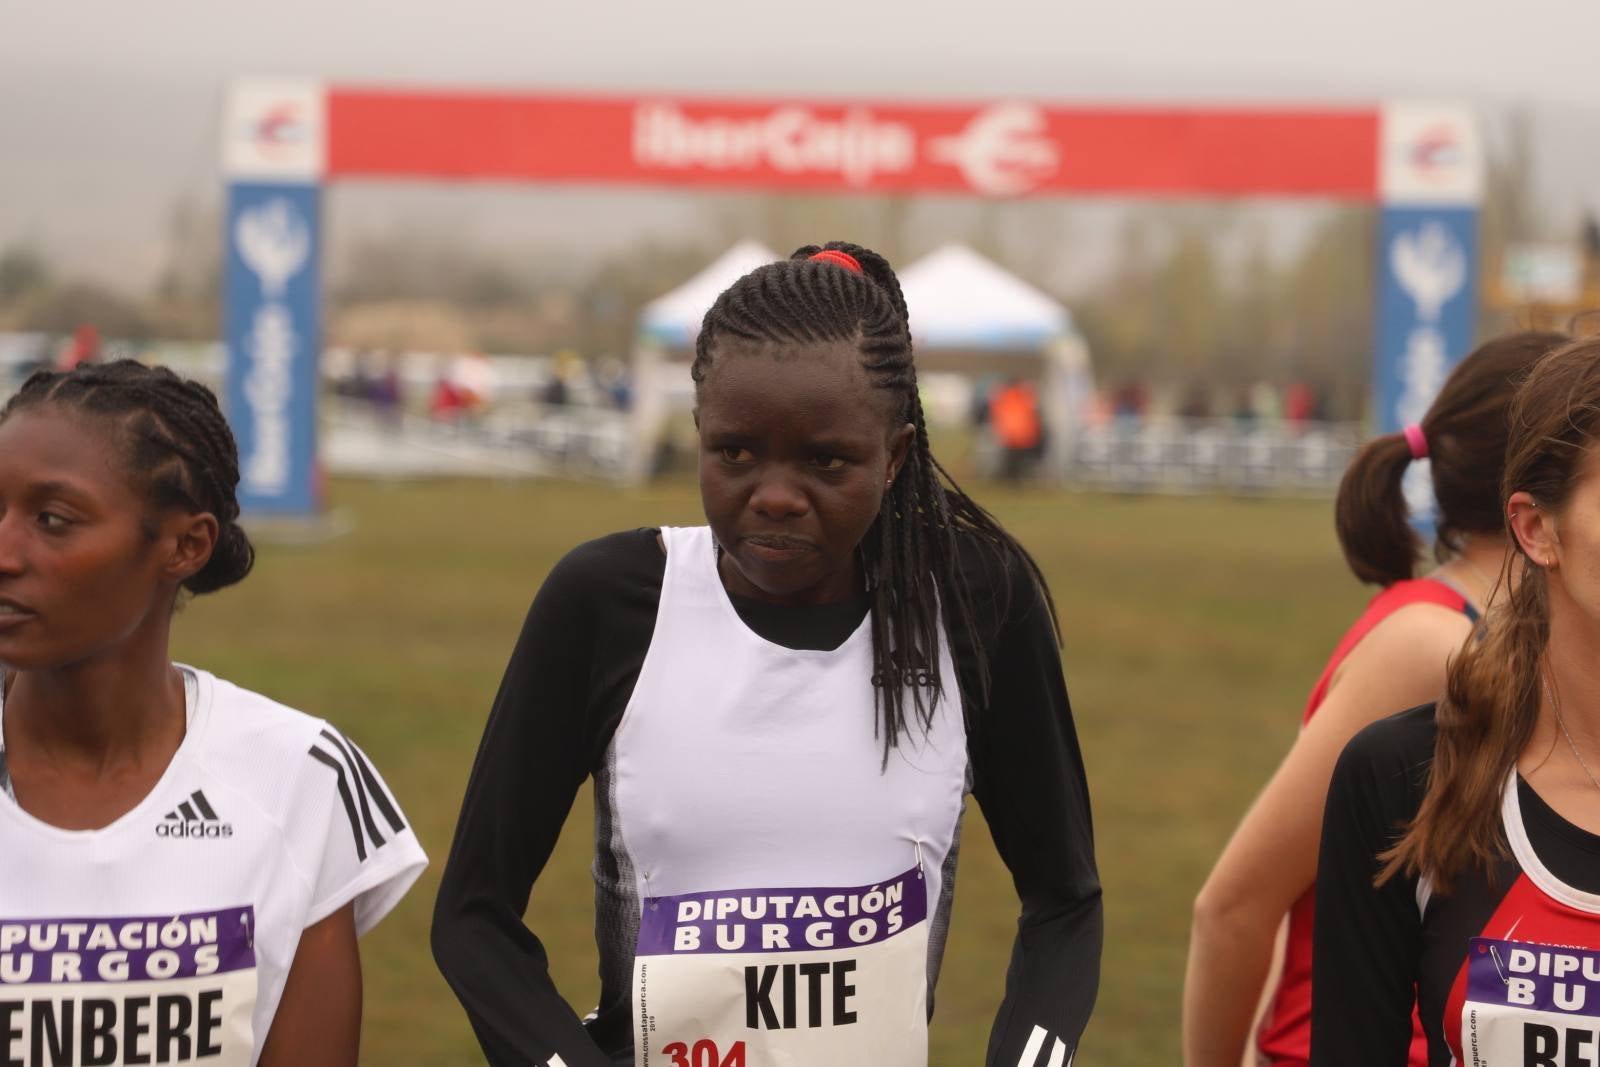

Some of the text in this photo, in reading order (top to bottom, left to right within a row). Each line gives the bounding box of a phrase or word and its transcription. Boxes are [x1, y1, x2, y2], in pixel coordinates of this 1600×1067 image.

[155, 820, 233, 838] adidas
[677, 881, 903, 923] DIPUTACIÓN
[0, 915, 217, 951] PUTACIÓN
[674, 905, 903, 951] BURGOS
[0, 944, 219, 984] URGOS
[1508, 949, 1600, 982] DIPU
[745, 959, 857, 1030] KITE
[1507, 976, 1586, 1011] BU
[0, 989, 223, 1067] ENBERE
[1523, 1022, 1600, 1067] BE
